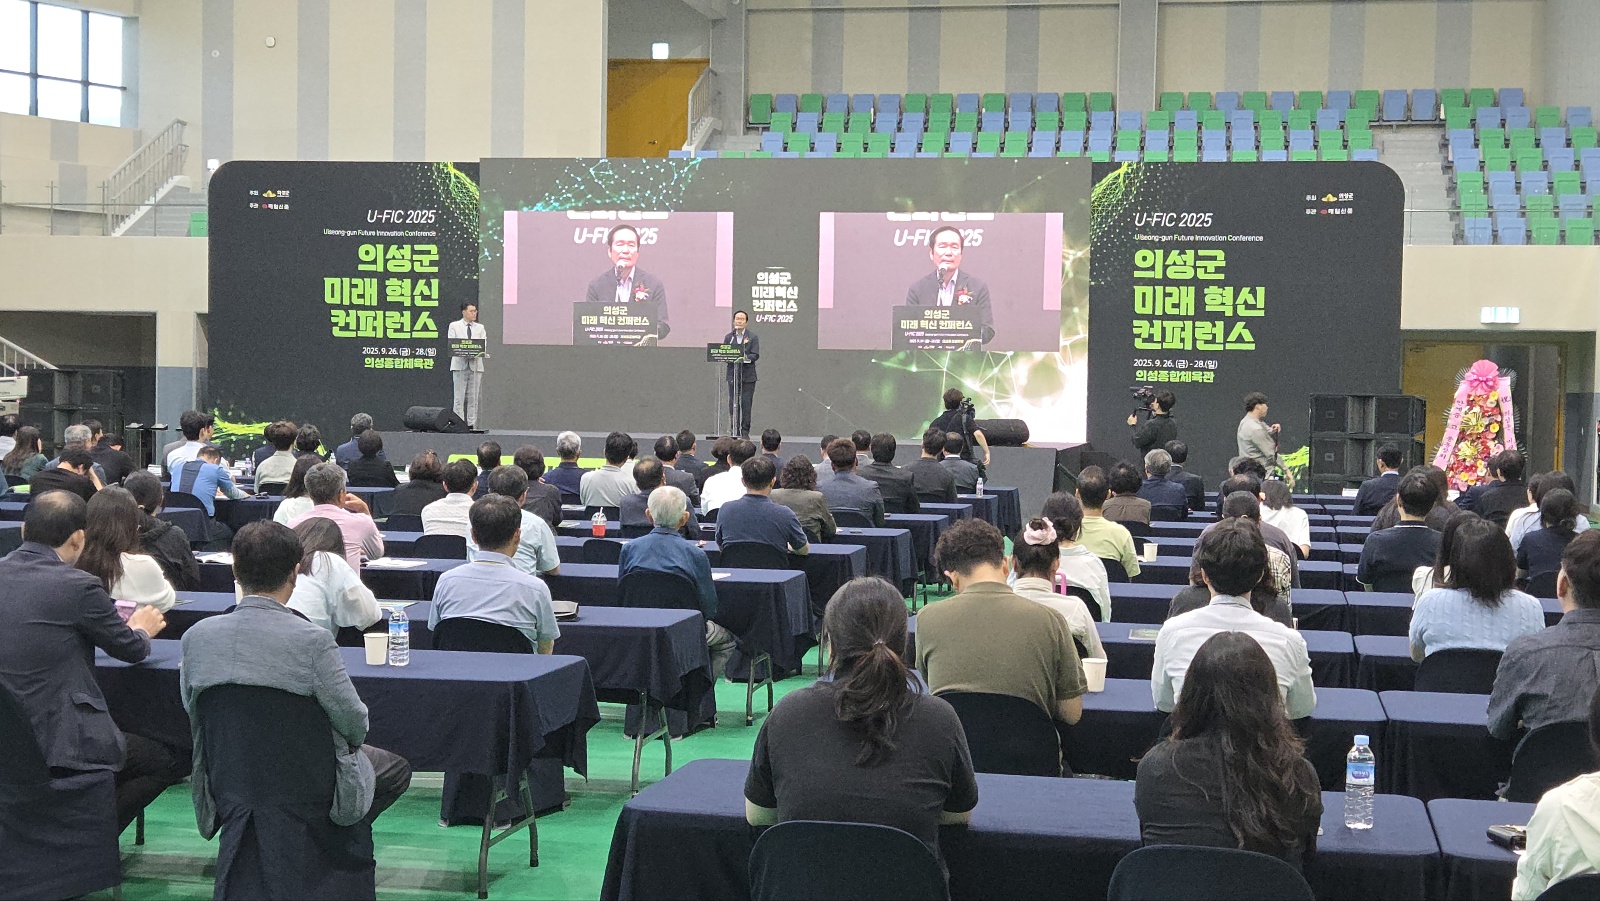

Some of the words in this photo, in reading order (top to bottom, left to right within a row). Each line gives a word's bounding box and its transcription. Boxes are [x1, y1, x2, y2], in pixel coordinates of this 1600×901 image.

[367, 209, 404, 223] U-FIC
[405, 209, 437, 224] 2025
[1134, 212, 1177, 227] U-FIC
[1178, 212, 1214, 227] 2025
[357, 229, 376, 237] Future
[376, 229, 404, 237] Innovation
[573, 226, 612, 244] U-FI
[893, 228, 935, 247] U-FI
[1173, 234, 1195, 242] Future
[1195, 234, 1227, 242] Innovation
[1227, 234, 1264, 242] Conference
[358, 243, 439, 273] 의성군
[1133, 249, 1226, 280] 의성군
[756, 271, 792, 285] 의성군
[323, 277, 378, 306] 미래
[385, 277, 439, 307] 혁신
[752, 299, 799, 312] 컨퍼런스
[1133, 285, 1195, 316] 미래
[1203, 285, 1265, 317] 혁신
[603, 305, 628, 315] 의성군
[923, 309, 950, 320] 의성군
[330, 309, 439, 339] 컨퍼런스
[581, 315, 598, 325] 미래
[599, 315, 616, 326] 혁신
[617, 316, 650, 326] 컨퍼런스
[755, 314, 777, 323] U-FIC
[776, 314, 794, 323] 2025
[900, 319, 919, 330] 미래
[919, 319, 938, 330] 혁신
[938, 320, 974, 330] 컨퍼런스
[1132, 319, 1256, 351] 컨퍼런스
[364, 357, 435, 370] 의성종합체육관
[1135, 369, 1215, 383] 의성종합체육관
